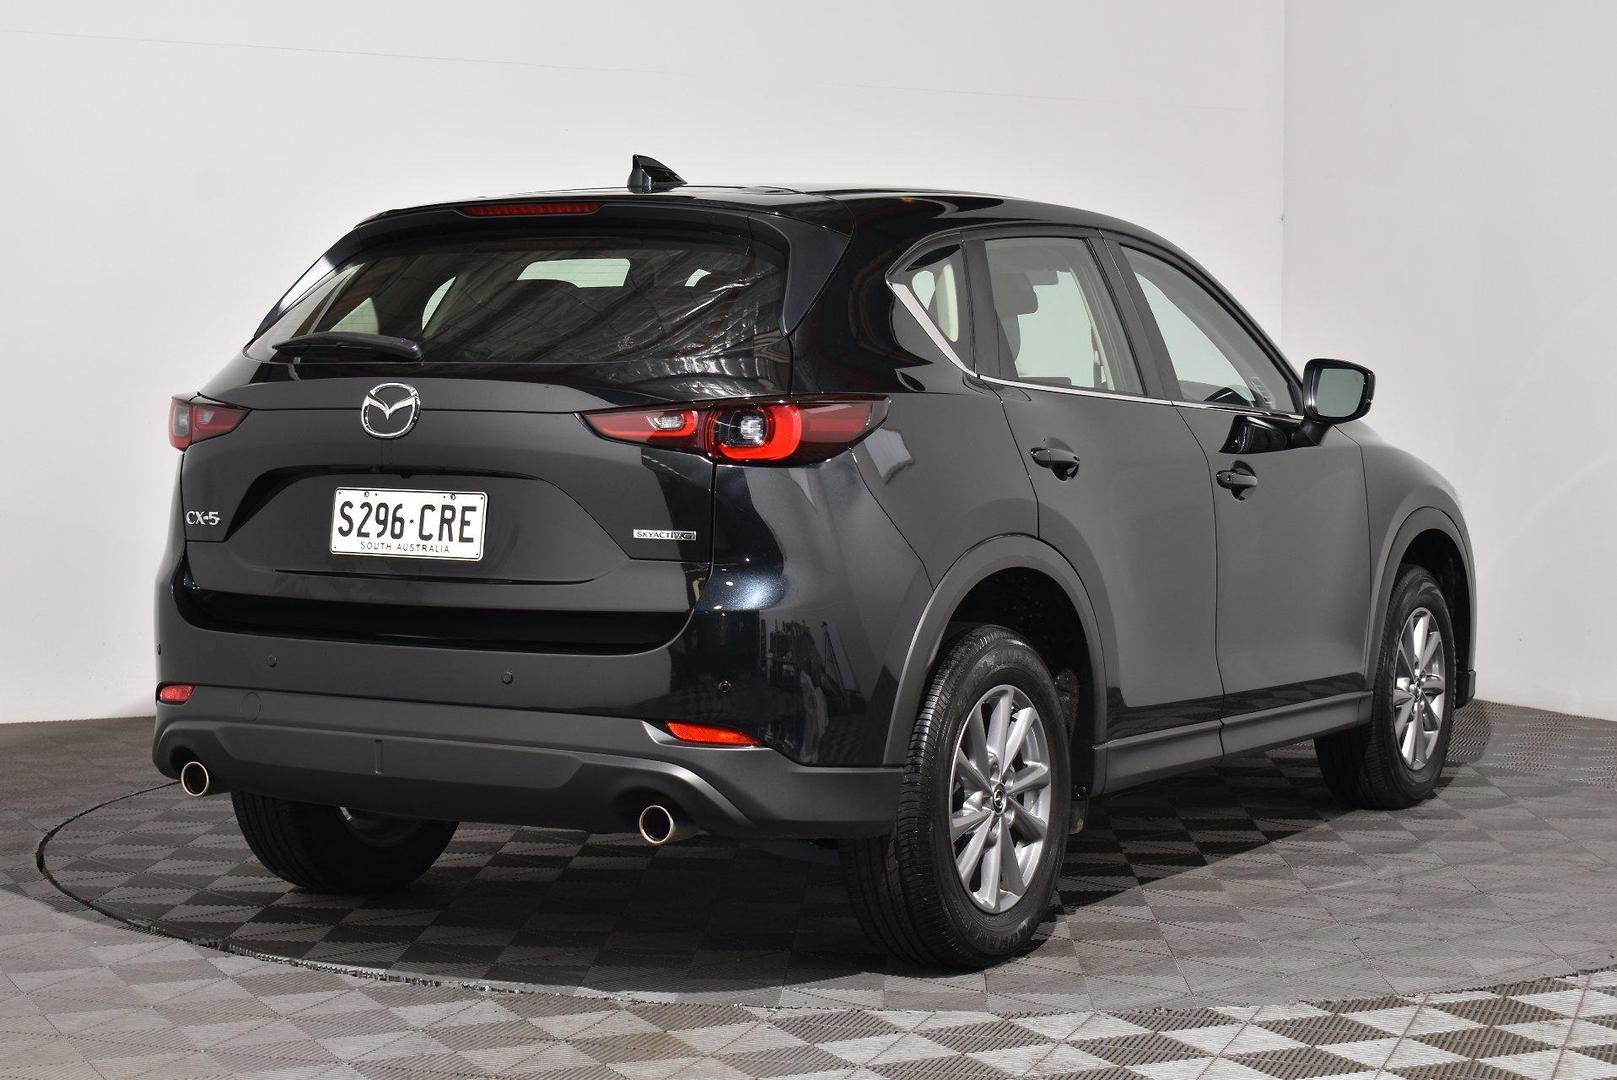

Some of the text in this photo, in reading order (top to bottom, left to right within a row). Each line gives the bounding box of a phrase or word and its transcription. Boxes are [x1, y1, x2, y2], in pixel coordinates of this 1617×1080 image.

[186, 510, 220, 526] CX-5
[360, 541, 450, 554] SOUTH AUSTRALIA
